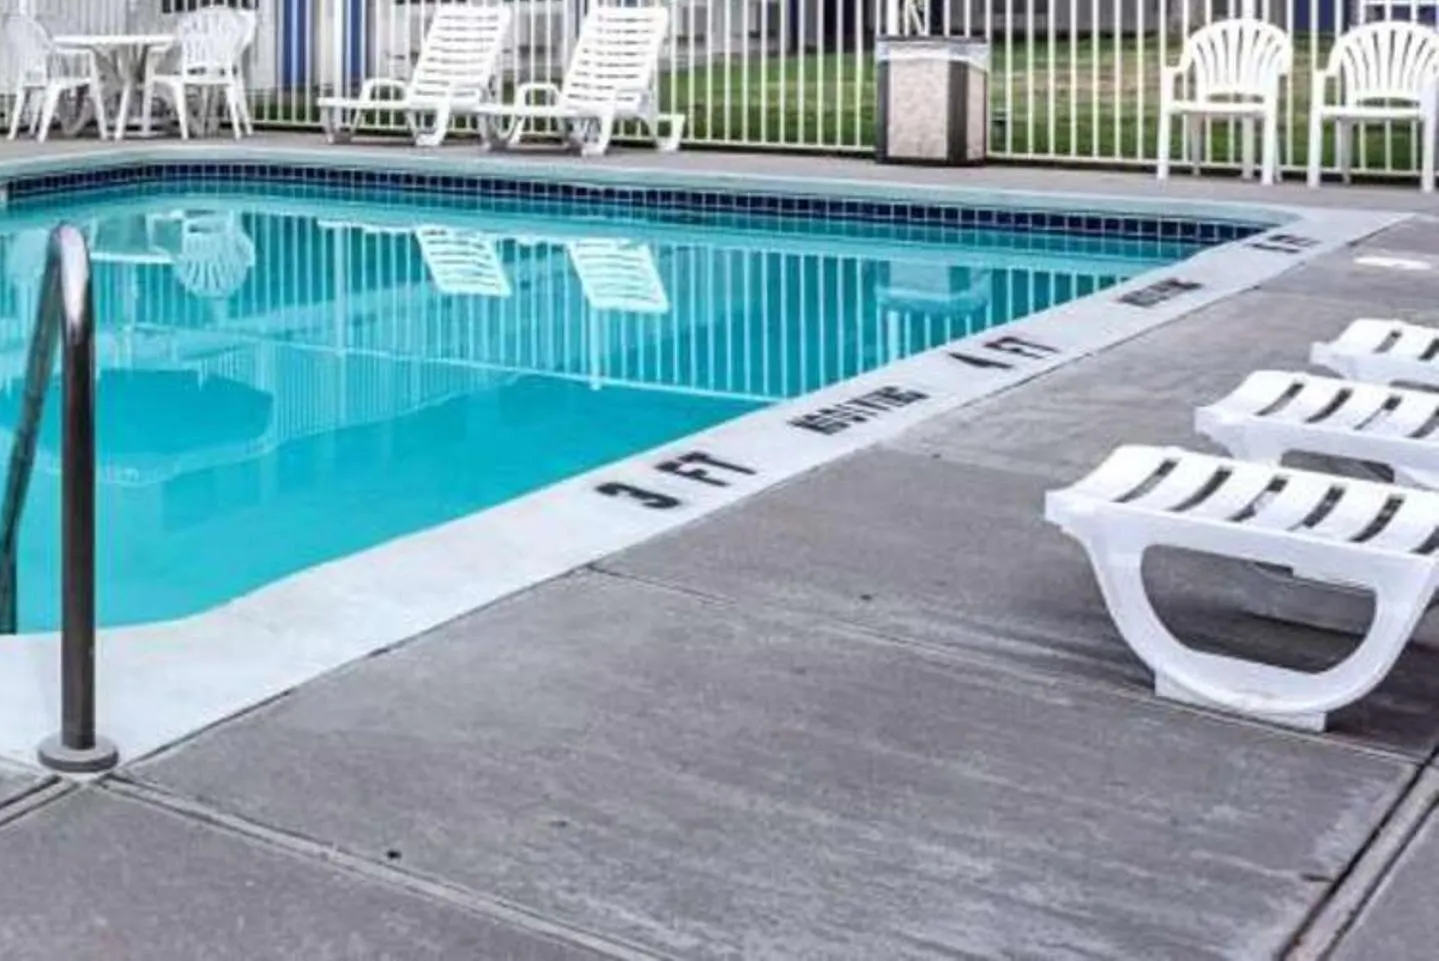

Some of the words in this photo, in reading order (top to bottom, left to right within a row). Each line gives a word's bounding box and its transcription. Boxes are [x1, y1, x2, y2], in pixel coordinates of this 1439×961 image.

[984, 336, 1059, 359] FT
[595, 481, 681, 509] 3
[655, 451, 756, 487] FT
